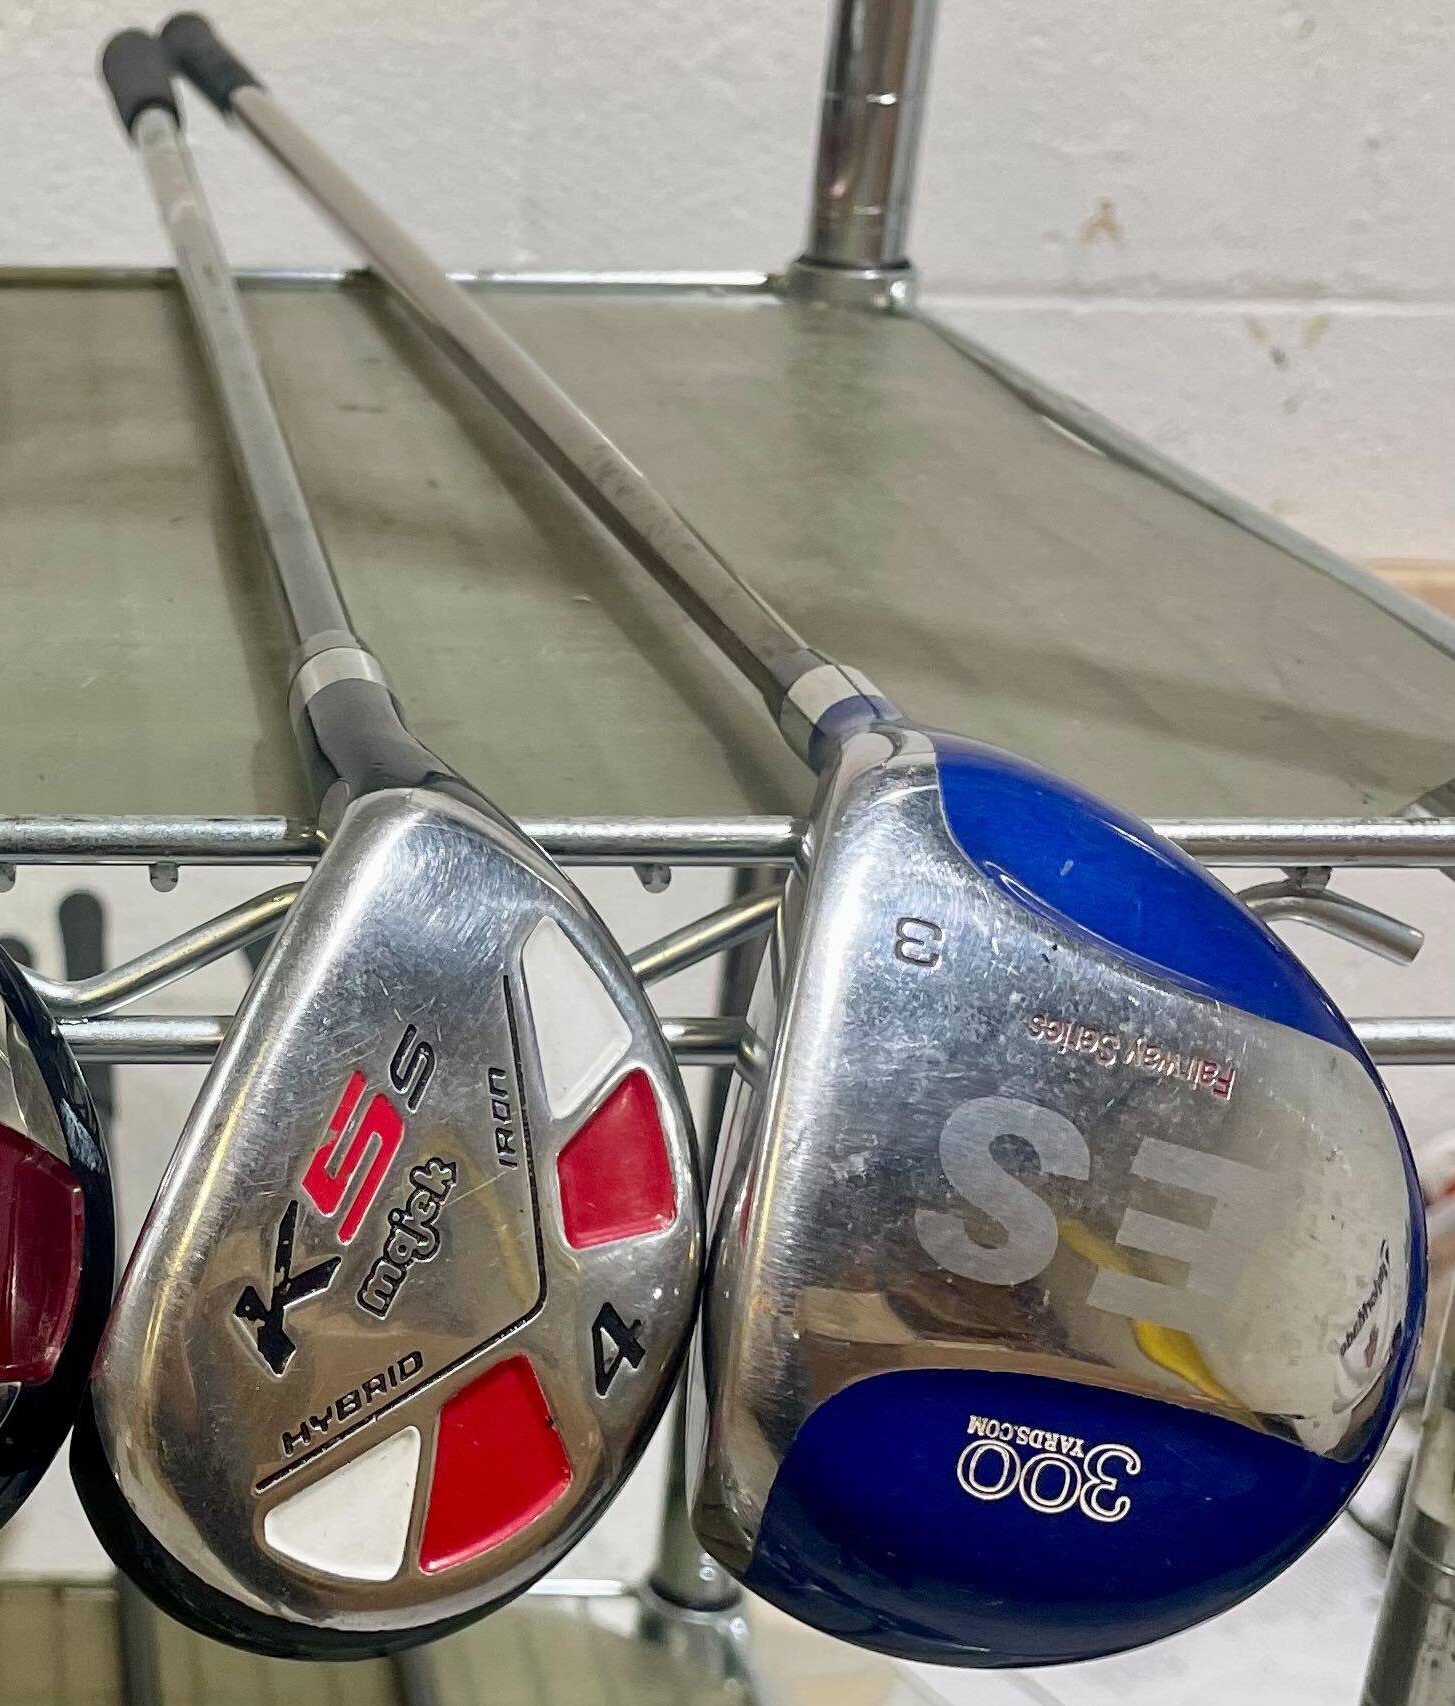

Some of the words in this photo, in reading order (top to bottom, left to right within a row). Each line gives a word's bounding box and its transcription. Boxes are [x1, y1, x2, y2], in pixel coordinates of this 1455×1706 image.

[893, 914, 943, 970] 3
[1026, 1012, 1122, 1068] Series
[1121, 1036, 1238, 1101] Fairway
[355, 1155, 459, 1321] majek
[591, 1300, 647, 1400] 4
[278, 1347, 425, 1458] HYBRID
[966, 1413, 1086, 1460] YARDS.COM
[956, 1437, 1144, 1524] 300
